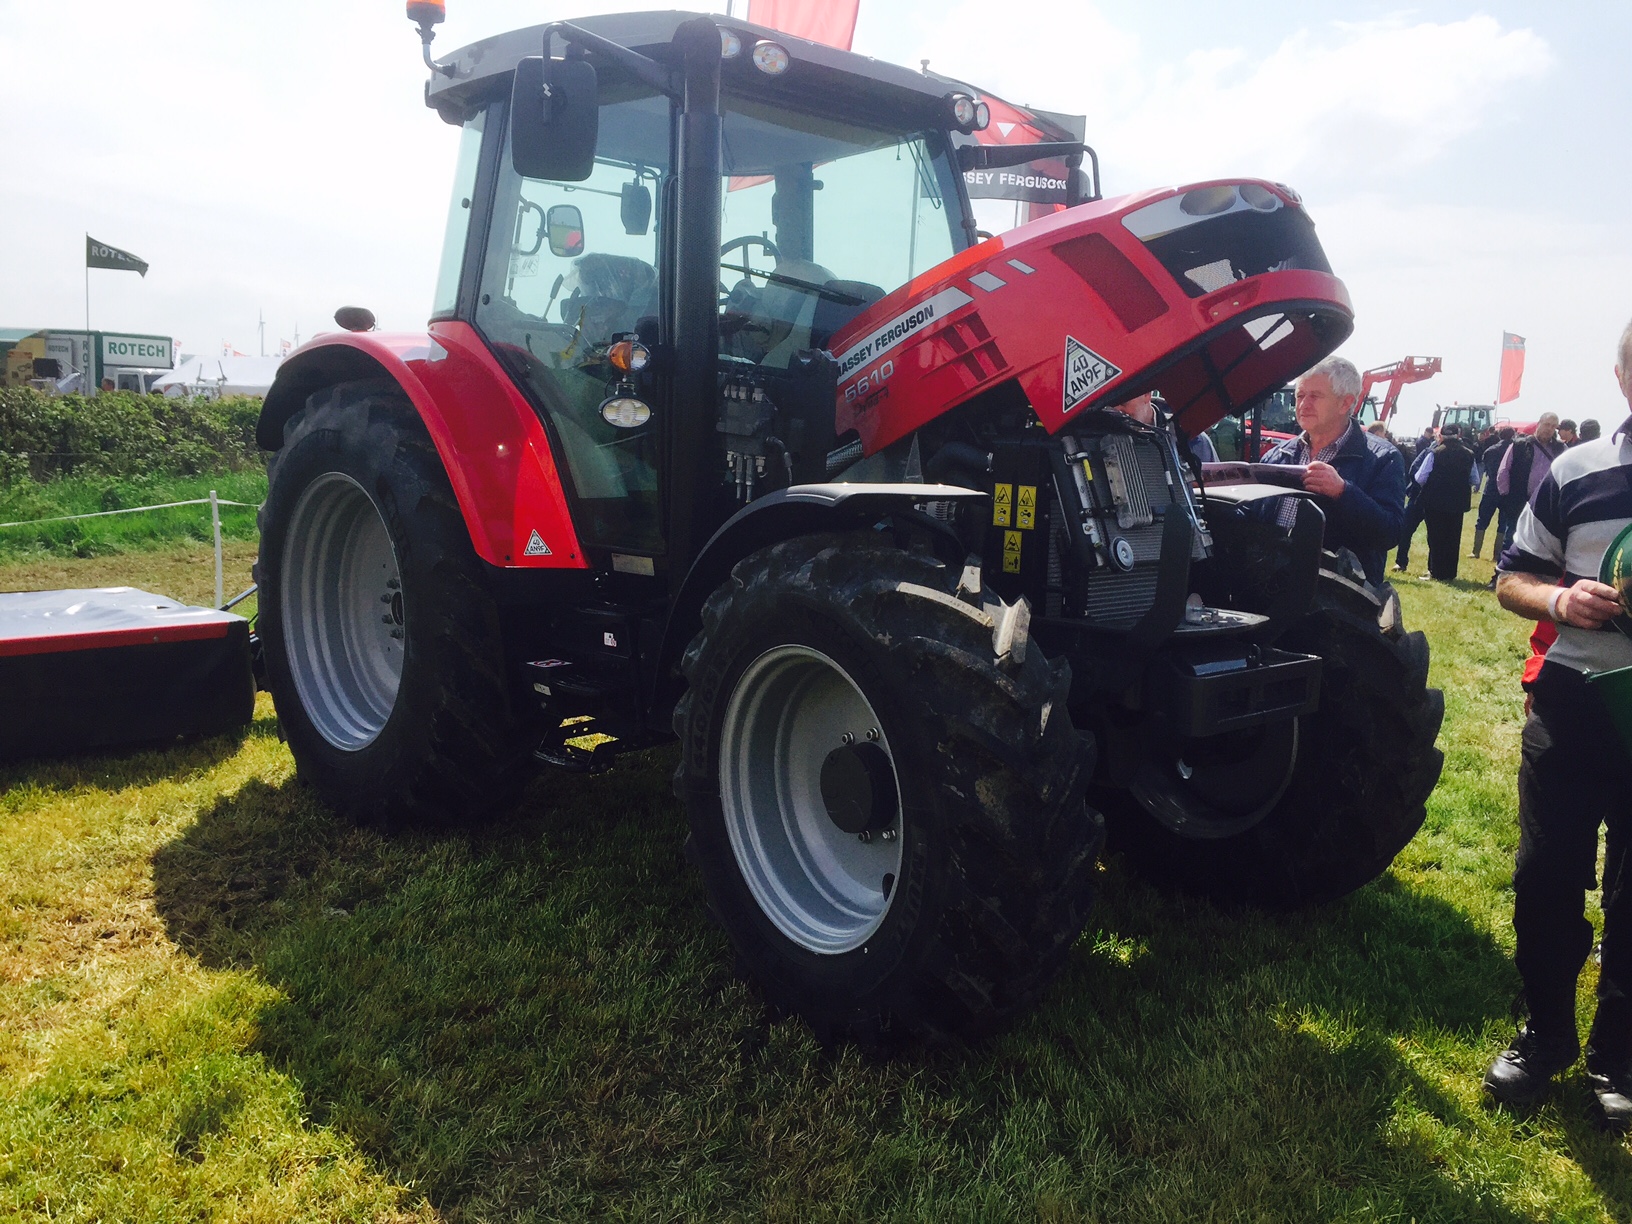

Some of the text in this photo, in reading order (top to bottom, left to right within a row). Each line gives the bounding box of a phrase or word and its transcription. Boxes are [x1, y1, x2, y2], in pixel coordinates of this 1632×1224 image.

[999, 172, 1067, 189] FERGUSON
[875, 304, 935, 352] FERGUSON
[108, 341, 165, 357] ROTECH
[844, 360, 894, 403] 5610
[1070, 362, 1102, 396] AN9F
